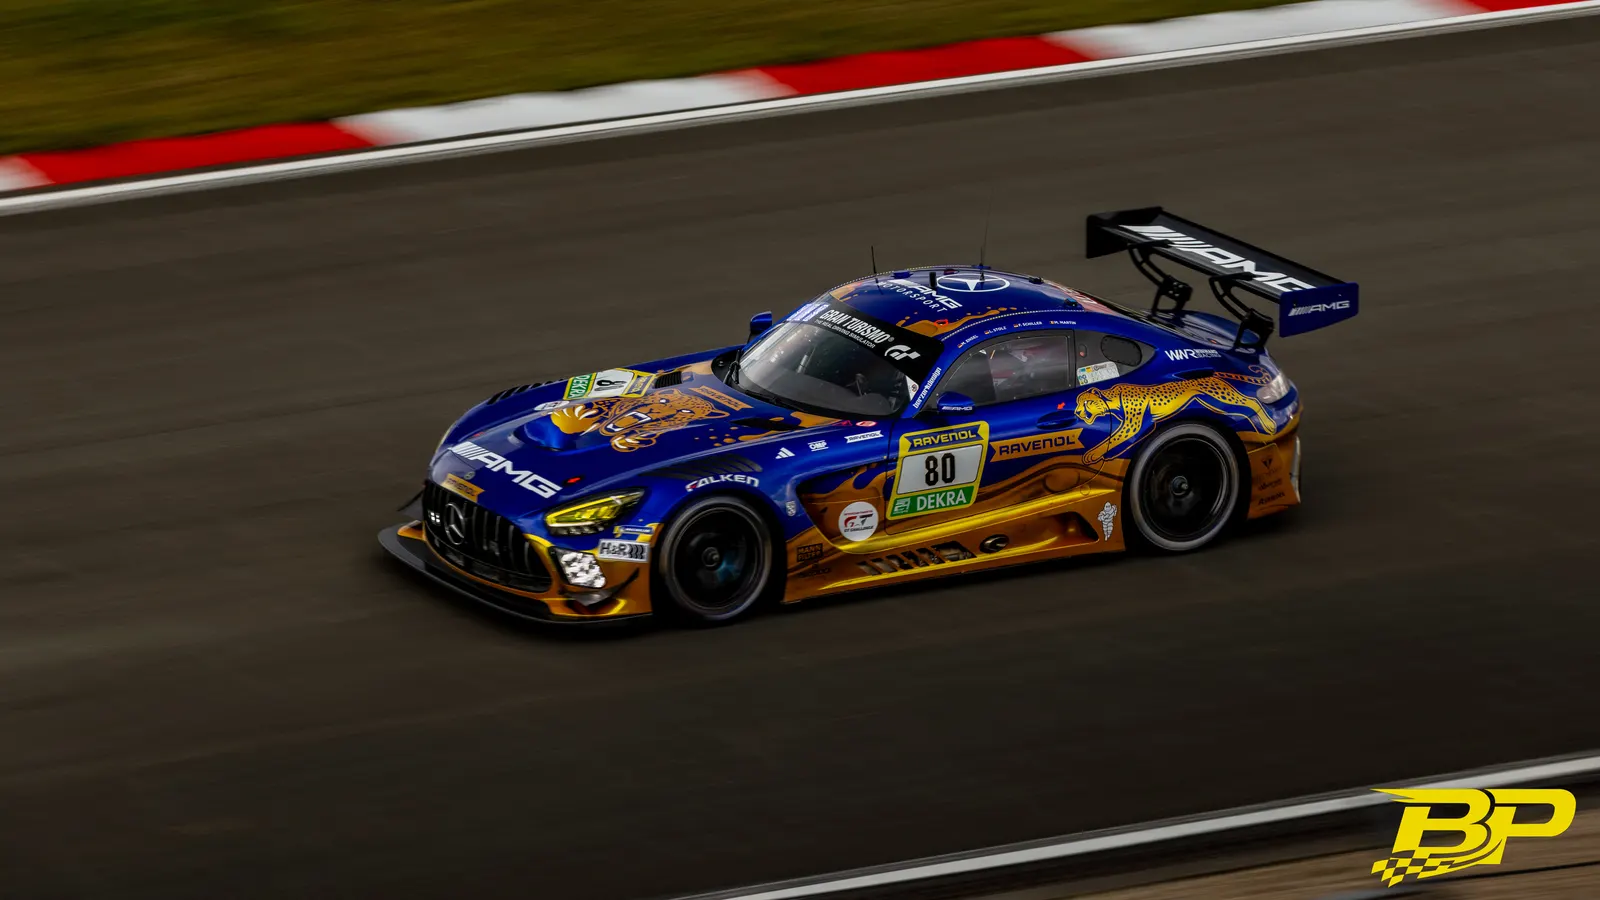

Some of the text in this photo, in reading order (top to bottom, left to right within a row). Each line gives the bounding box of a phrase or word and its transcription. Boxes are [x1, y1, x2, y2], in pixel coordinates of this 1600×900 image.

[877, 281, 948, 312] MOTORSPORT
[911, 285, 963, 309] AMG
[819, 309, 852, 327] GRAN
[912, 429, 977, 448] RAVENOL
[998, 437, 1076, 456] RAVENOL
[463, 450, 563, 498] AMG
[924, 453, 956, 486] 80
[685, 474, 760, 492] FALKEN
[916, 489, 968, 511] DEKRA
